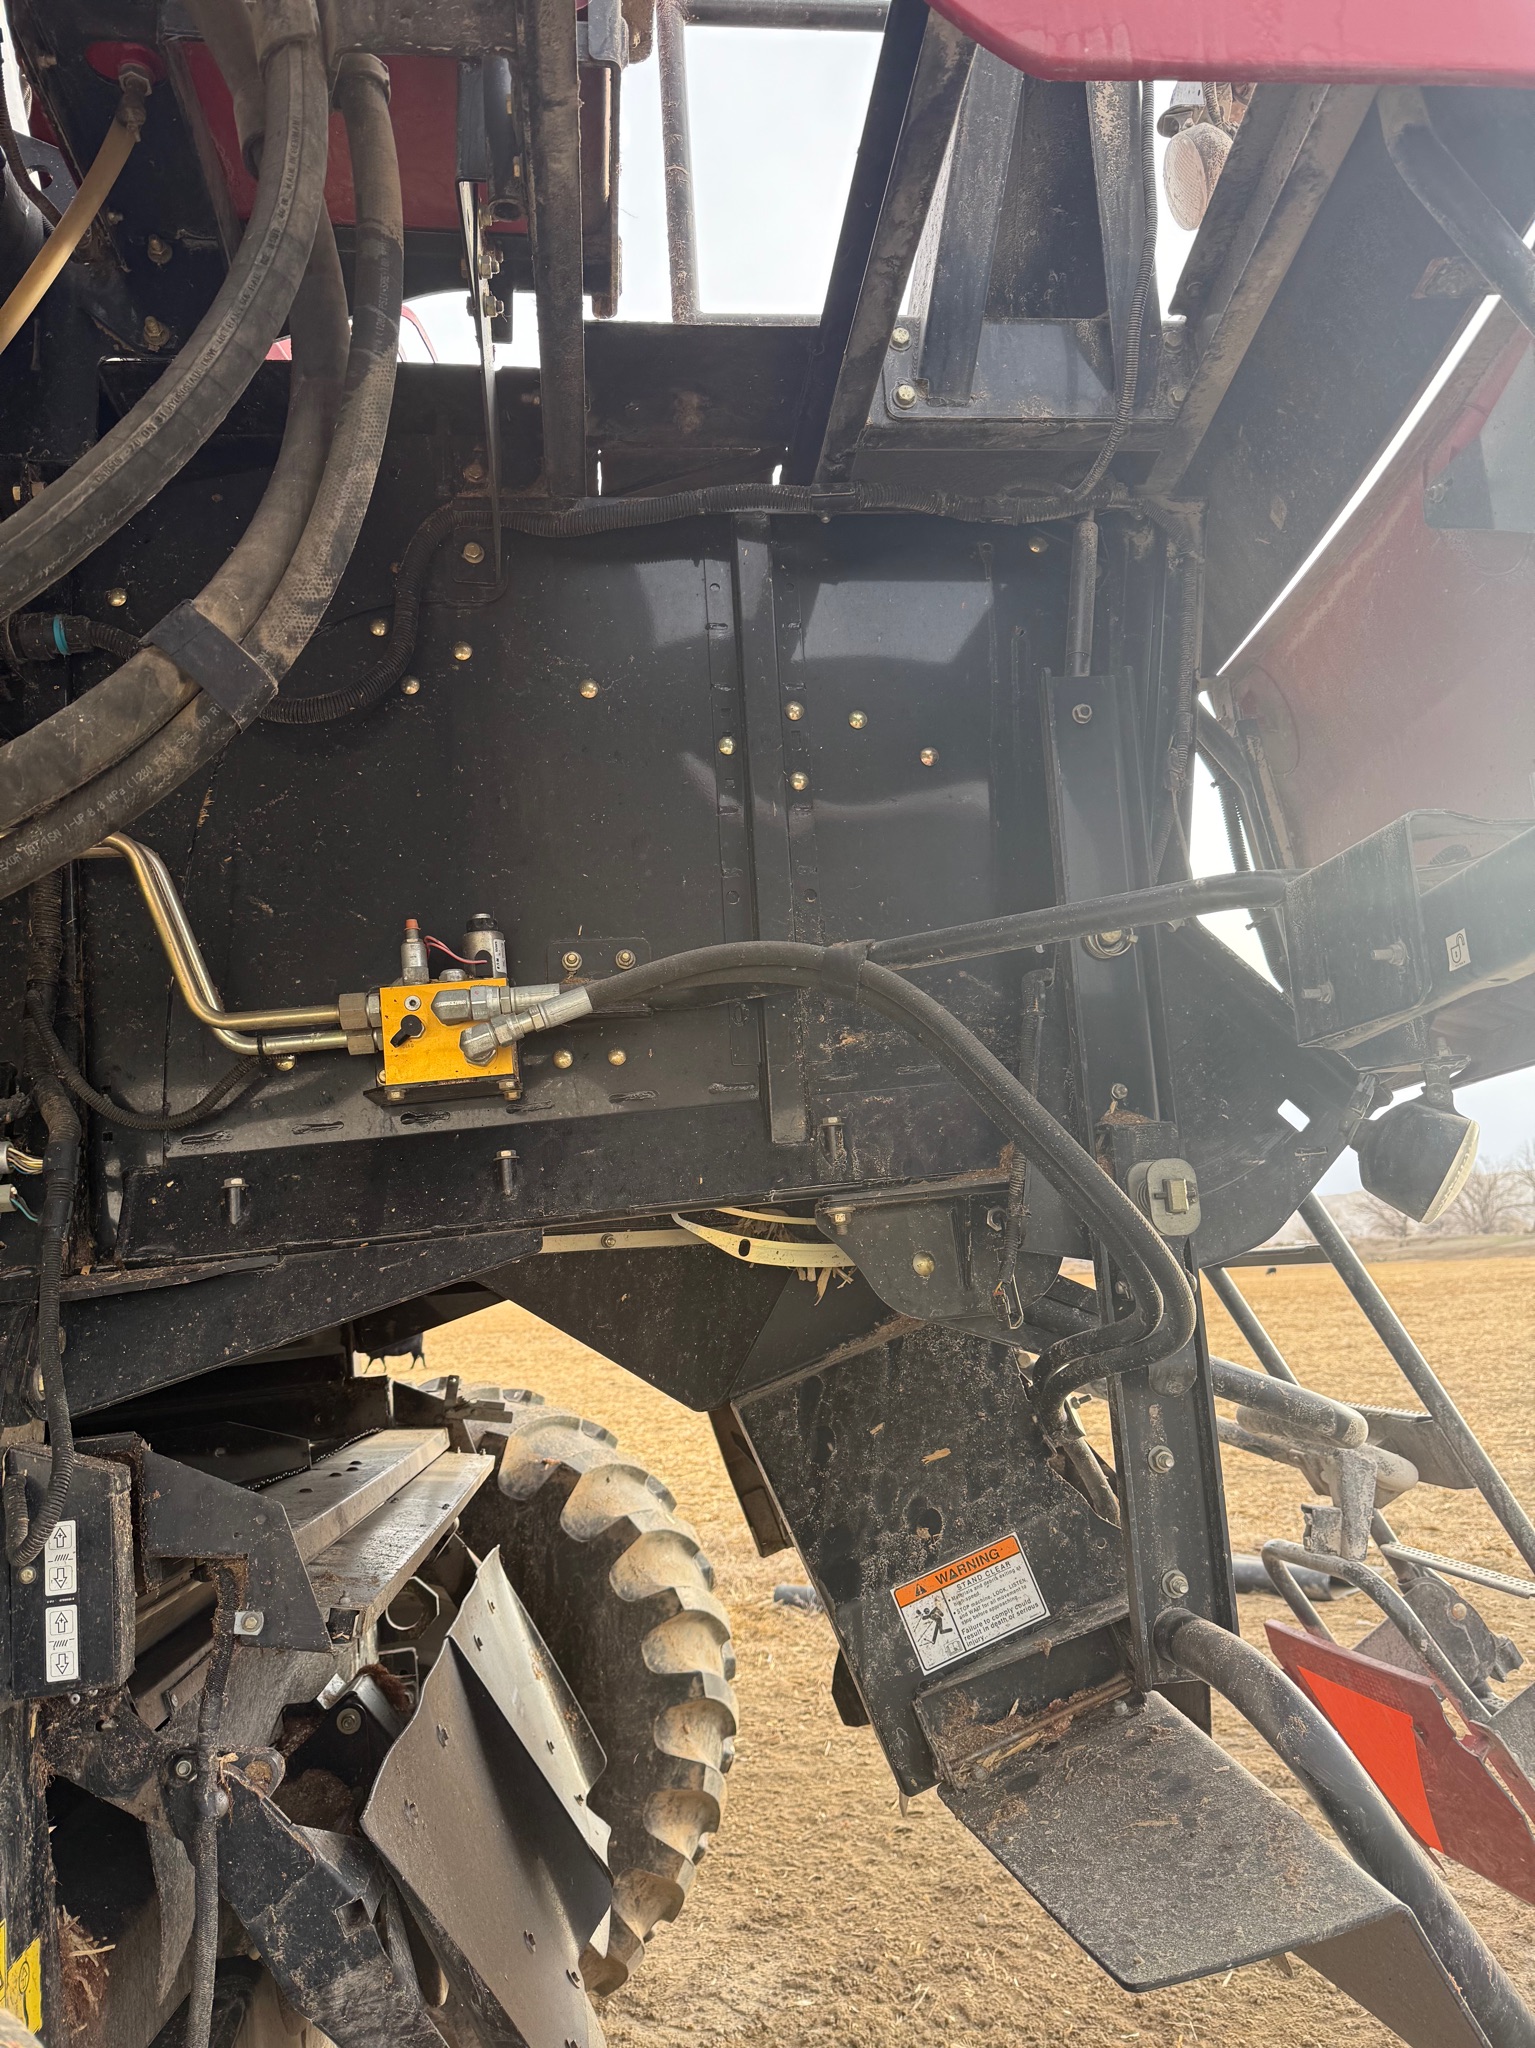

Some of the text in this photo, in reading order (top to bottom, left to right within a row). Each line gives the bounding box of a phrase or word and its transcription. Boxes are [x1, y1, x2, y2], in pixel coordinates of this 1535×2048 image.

[86, 799, 105, 816] 8.8
[106, 787, 126, 803] MPa
[126, 765, 152, 787] (1280
[935, 1548, 1000, 1584] WARNING
[956, 1561, 1010, 1589] STAND CLEAR
[951, 1588, 972, 1600] Materials
[983, 1575, 998, 1585] debris
[999, 1568, 1015, 1578] exiting
[956, 1604, 970, 1613] STOP
[961, 1621, 983, 1634] Failure
[991, 1607, 1014, 1622] comply
[1014, 1598, 1031, 1610] could
[968, 1605, 981, 1614] WAIT
[996, 1587, 1021, 1601] movement
[961, 1617, 972, 1625] stop
[973, 1609, 988, 1619] before
[964, 1629, 981, 1640] result
[990, 1617, 1007, 1628] death
[1016, 1602, 1038, 1615] serious
